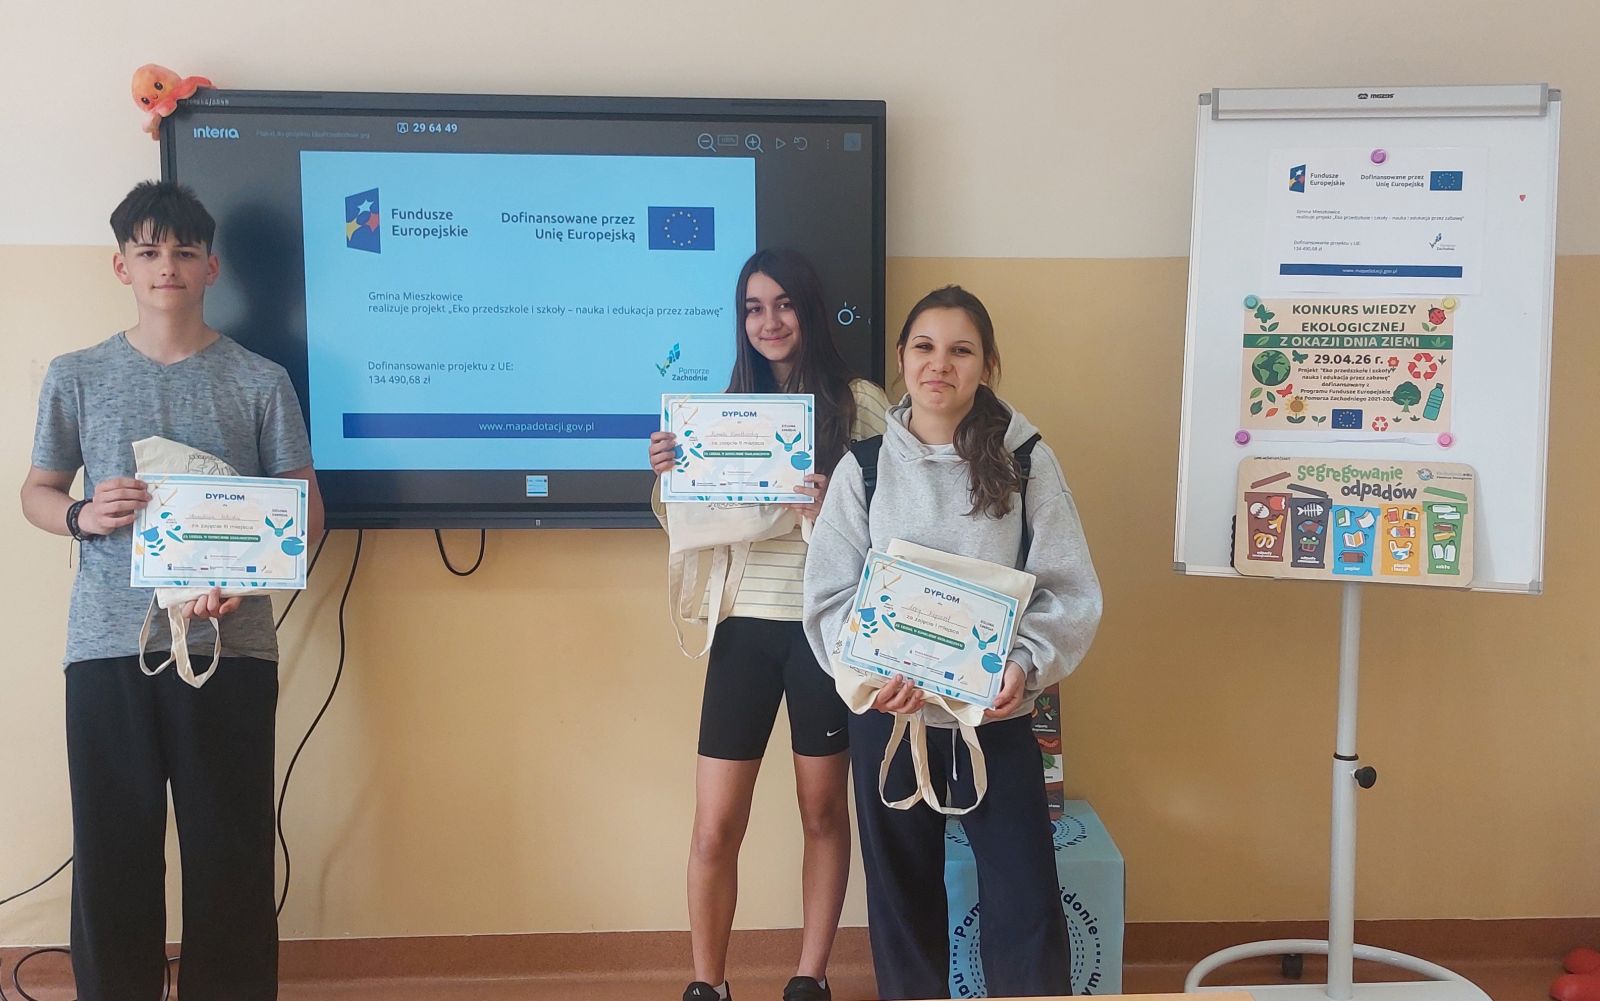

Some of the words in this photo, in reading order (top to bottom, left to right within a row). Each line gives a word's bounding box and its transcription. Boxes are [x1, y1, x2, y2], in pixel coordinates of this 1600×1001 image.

[413, 122, 426, 132] 29
[429, 122, 442, 132] 64
[445, 122, 458, 132] 49
[391, 208, 454, 220] Fundusze
[501, 212, 598, 224] Dofinansowane
[602, 216, 636, 226] przez
[392, 224, 468, 239] Europejskie
[536, 228, 564, 242] Unię
[568, 228, 636, 243] Europejską
[368, 292, 400, 301] Gmina
[403, 292, 464, 301] Mieszkowice
[368, 304, 409, 315] realizuje
[412, 304, 446, 316] projekt
[448, 304, 470, 314] „Eko
[472, 304, 529, 316] przedszkole
[531, 305, 534, 314] i
[536, 305, 566, 316] szkoły
[576, 306, 604, 315] nauka
[608, 306, 610, 315] i
[612, 306, 654, 317] edukacja
[656, 308, 682, 318] przez
[1292, 304, 1358, 314] KONKURS
[1362, 304, 1416, 314] WIEDZY
[1302, 322, 1405, 332] EKOLOGICZNEJ
[1280, 336, 1288, 346] Z
[1292, 336, 1340, 346] OKAZJI
[1344, 337, 1378, 346] DNIA
[1381, 337, 1420, 347] ZIEMI
[1314, 354, 1372, 364] 29.04.26
[1374, 356, 1384, 364] r.
[368, 360, 446, 371] Dofinansowanie
[448, 361, 488, 373] projektu
[498, 362, 514, 371] UE:
[678, 366, 710, 374] Pomorze
[368, 376, 386, 384] 134
[388, 376, 421, 386] 490,68
[424, 376, 430, 384] zł
[478, 422, 594, 433] www.mapadotacji.gov.pl
[1297, 464, 1403, 482] segregowanie
[1340, 479, 1418, 501] odpadów
[205, 492, 245, 501] DYPLOM
[924, 587, 960, 604] DYPLOM
